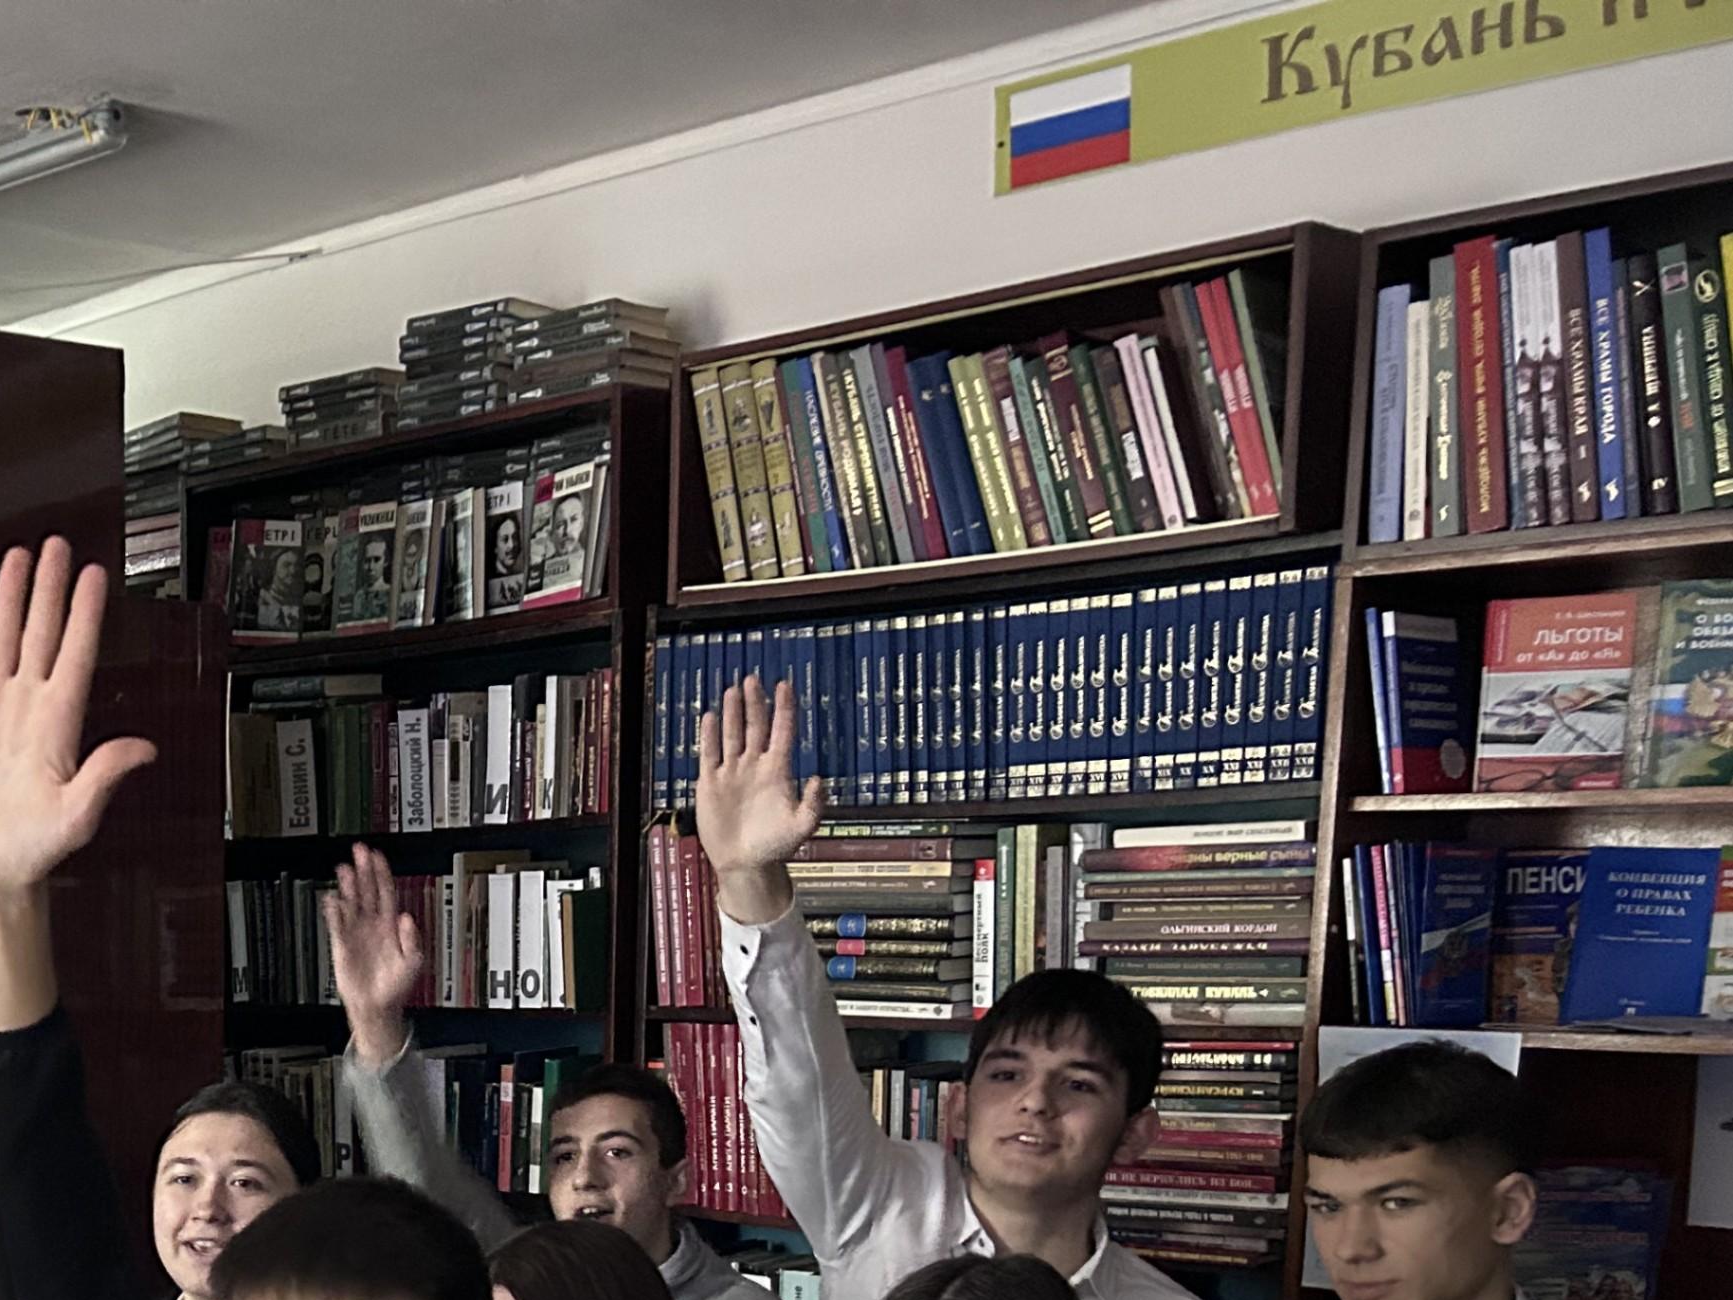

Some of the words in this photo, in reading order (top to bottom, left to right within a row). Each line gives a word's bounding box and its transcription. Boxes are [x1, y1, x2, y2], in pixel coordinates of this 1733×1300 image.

[1594, 297, 1610, 326] ВСЕ
[1568, 338, 1585, 393] ХРАМЫ
[1595, 329, 1613, 382] ХРАМЫ
[1572, 395, 1588, 435] КРАЯ
[1598, 385, 1617, 443] ГОРОДА
[1533, 626, 1624, 646] ЛЬГОТЫ
[406, 717, 421, 733] Н.
[284, 736, 306, 756] С.
[285, 760, 310, 828] Есенин
[405, 737, 425, 826] Заболоцкий
[484, 784, 508, 815] И
[1214, 850, 1268, 864] верные
[1608, 871, 1707, 886] КОНВЕНЦИЯ
[1616, 889, 1628, 898] О
[1631, 889, 1692, 901] ПРАВАХ
[1616, 903, 1686, 917] РЕБЕНКА
[974, 893, 982, 962] Бессмертный
[1160, 923, 1230, 934] ОЛЬГИНСКИЙ
[1233, 923, 1277, 933] КОРДОН
[490, 970, 511, 998] Н
[520, 969, 540, 998] О
